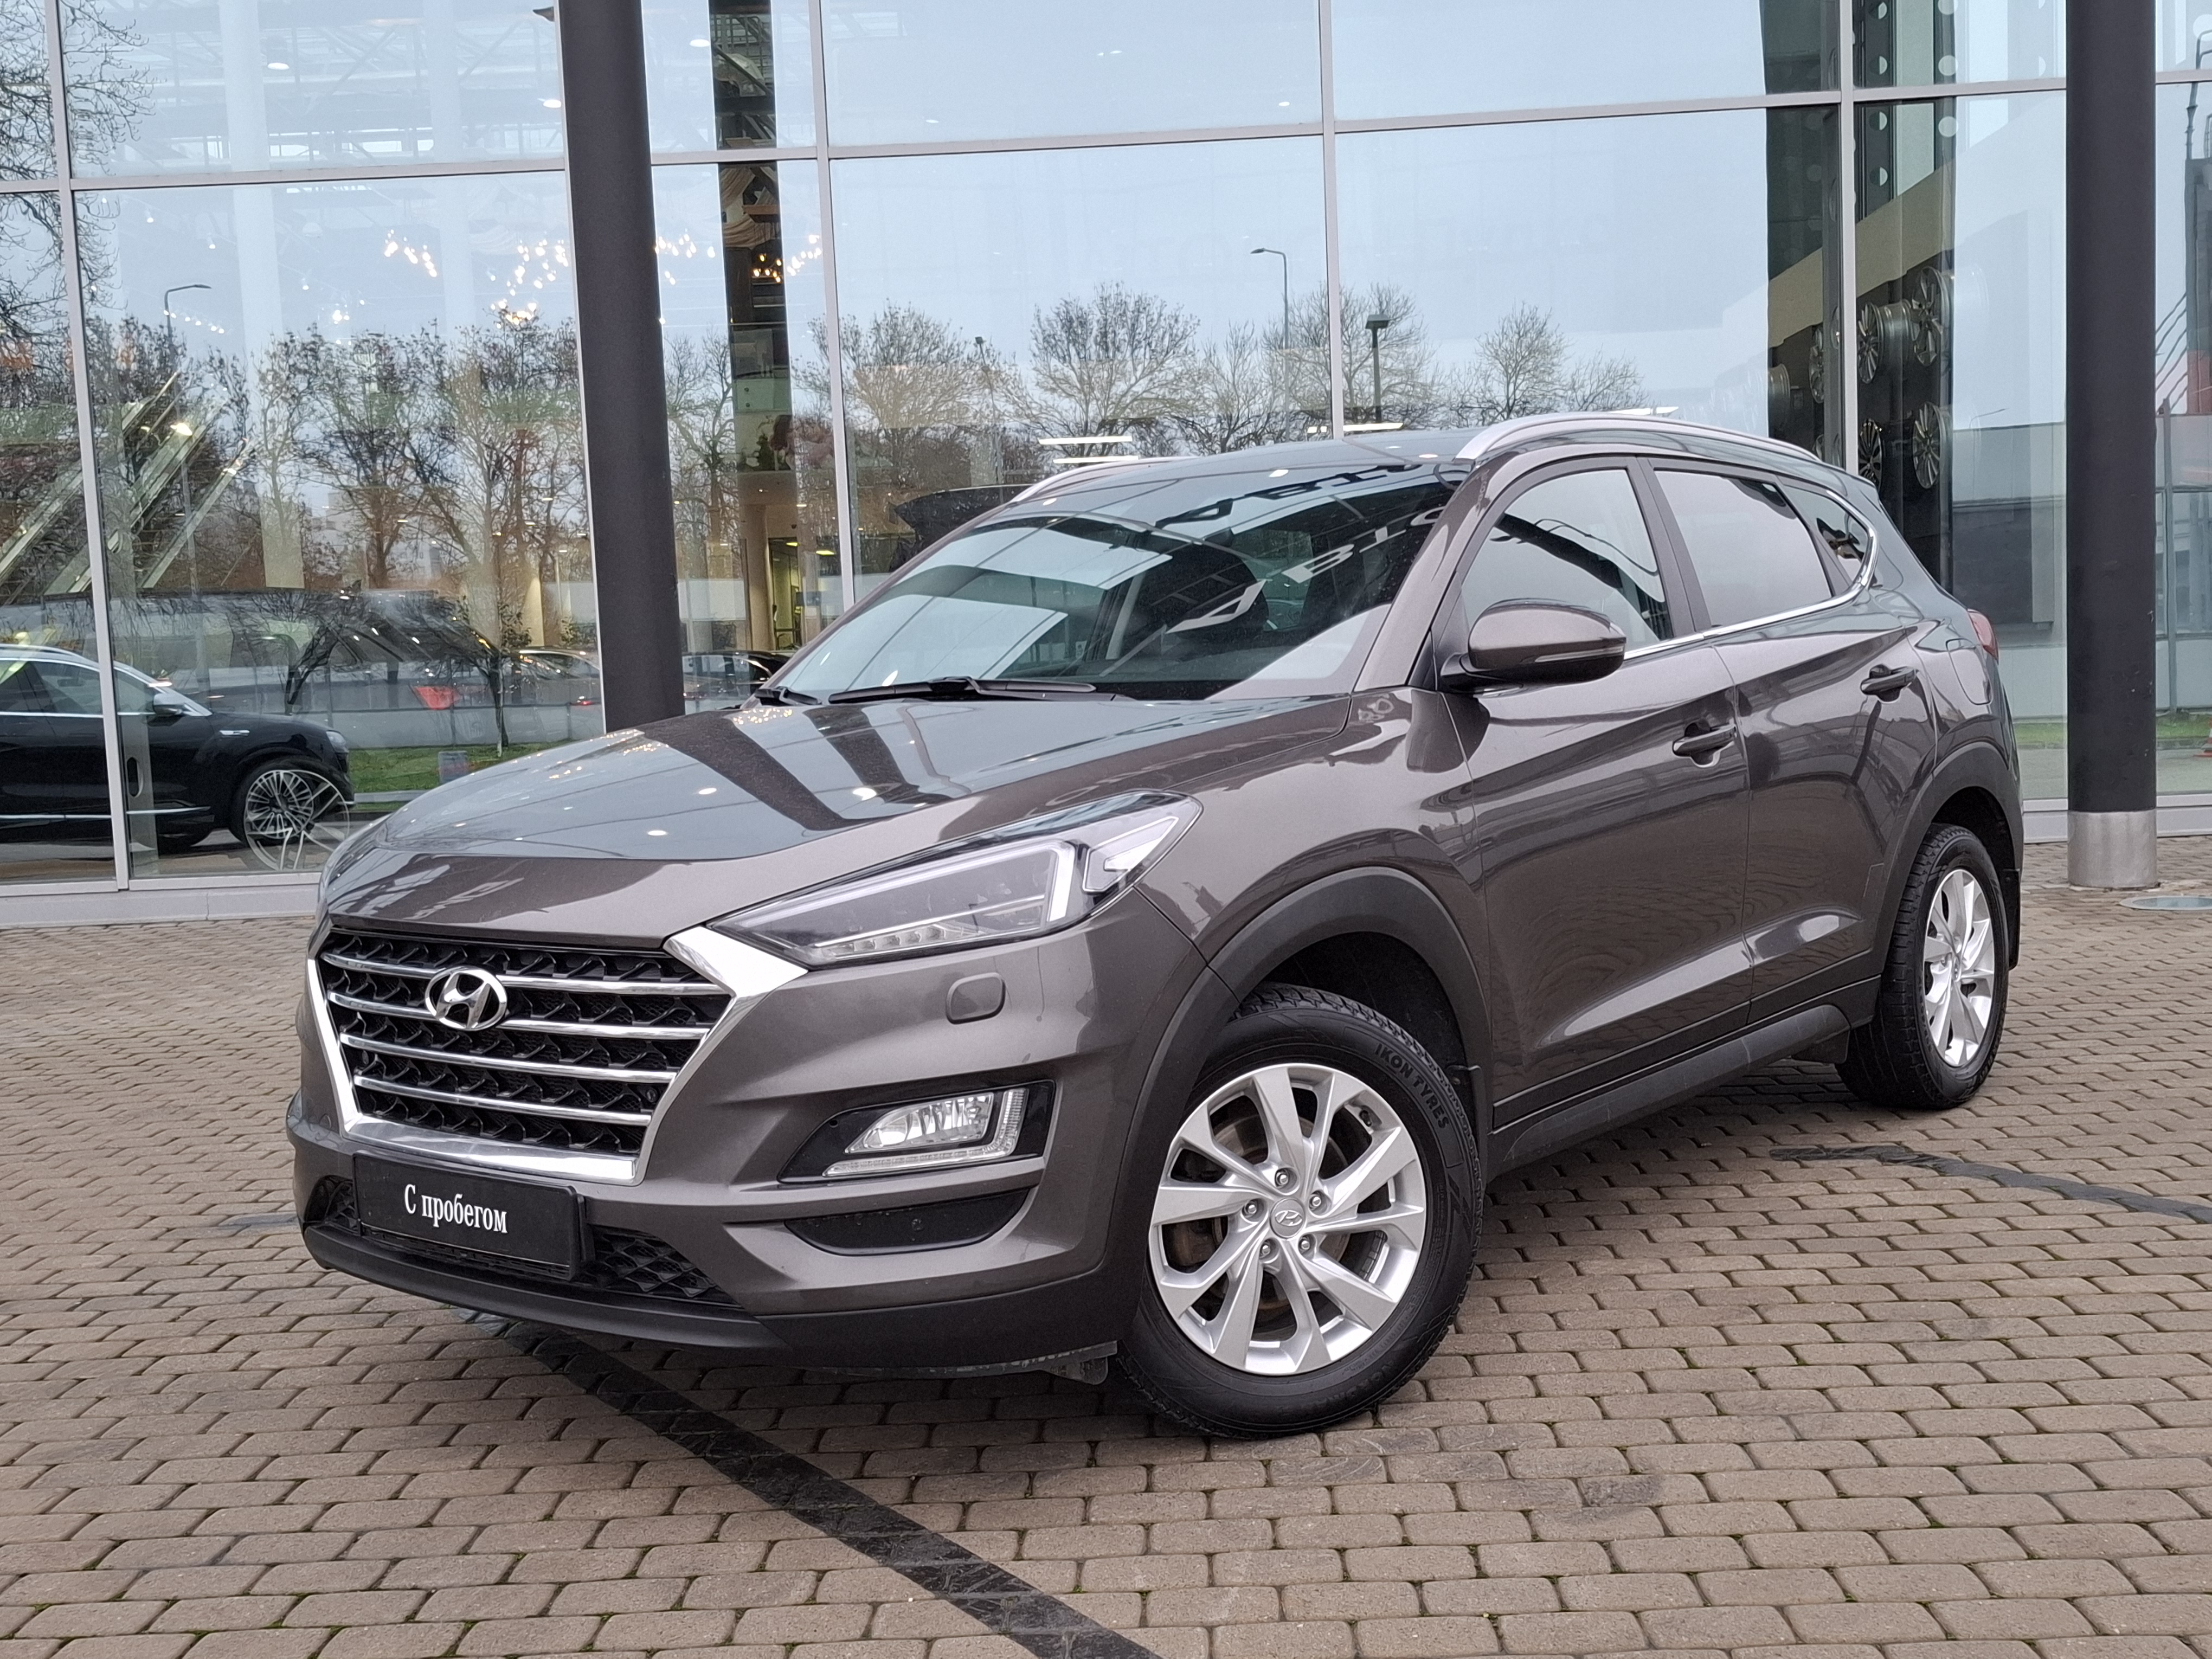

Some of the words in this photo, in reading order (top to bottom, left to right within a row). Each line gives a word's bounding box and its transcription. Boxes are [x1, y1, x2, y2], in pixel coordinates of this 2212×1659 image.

[1374, 1043, 1414, 1079] IKON
[1413, 1075, 1450, 1129] TYRES
[404, 1184, 416, 1214] С
[421, 1193, 508, 1233] пробегом
